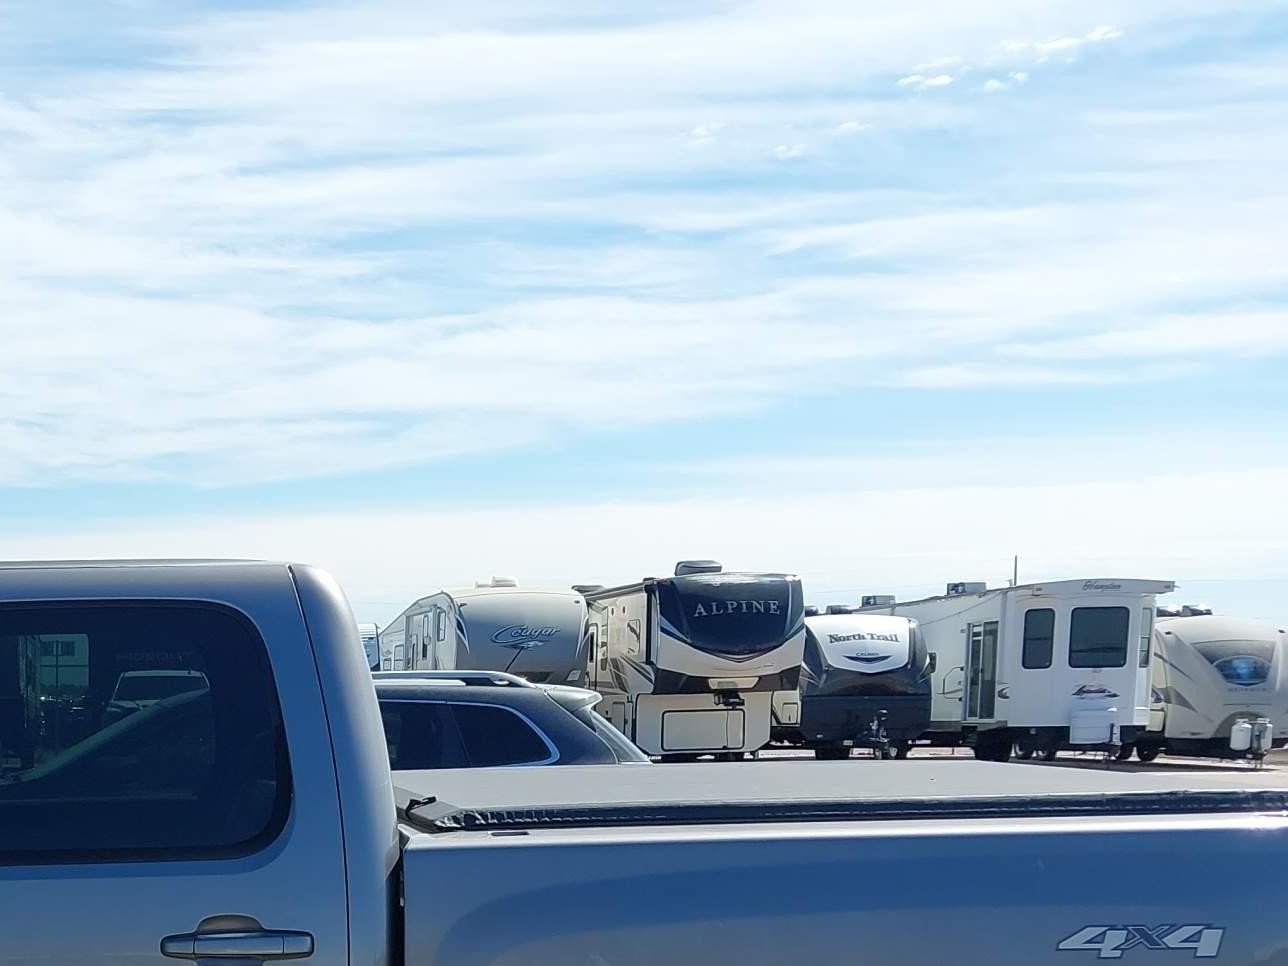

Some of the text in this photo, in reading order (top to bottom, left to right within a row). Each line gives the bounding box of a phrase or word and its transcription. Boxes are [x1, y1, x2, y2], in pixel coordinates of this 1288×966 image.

[693, 600, 781, 617] ALPINE
[491, 625, 561, 644] Cougar
[827, 633, 899, 644] North Trail
